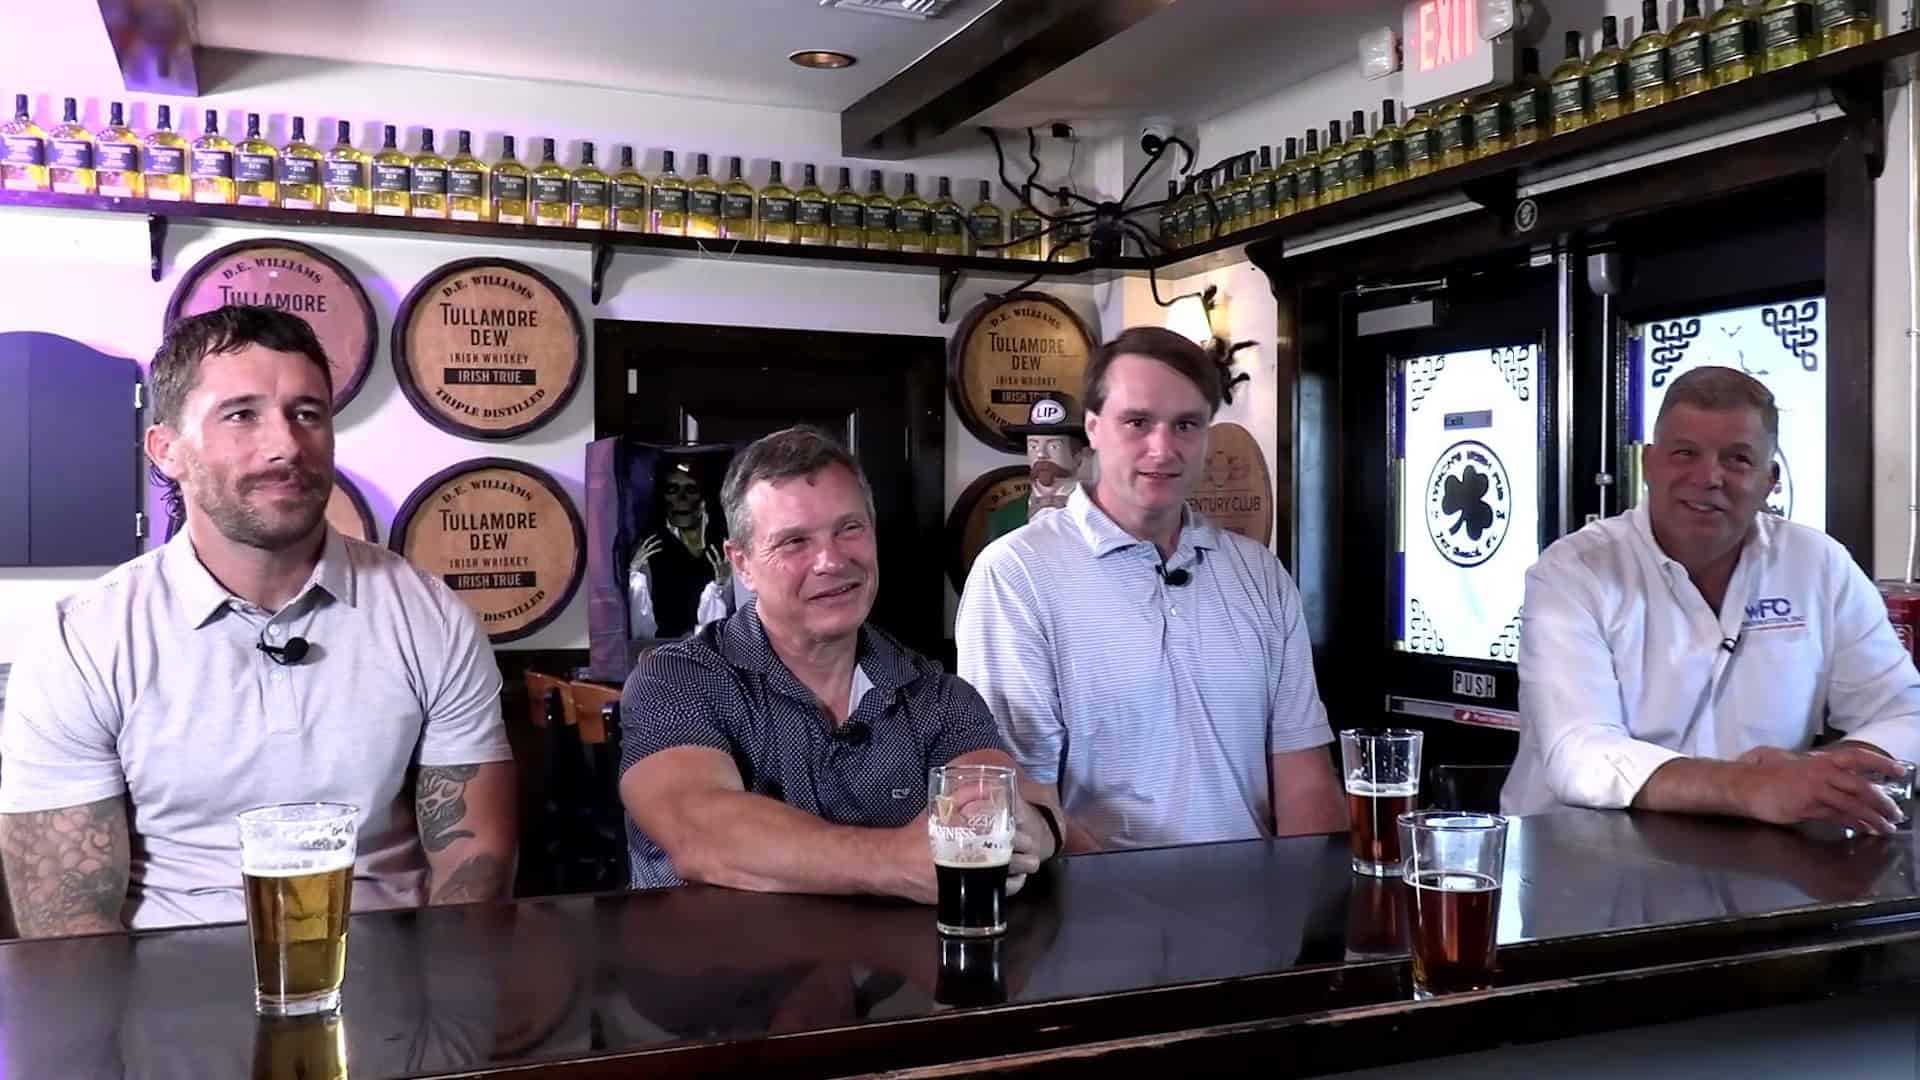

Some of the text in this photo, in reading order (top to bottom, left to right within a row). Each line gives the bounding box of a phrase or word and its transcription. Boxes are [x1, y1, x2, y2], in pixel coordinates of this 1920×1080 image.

[255, 257, 322, 283] WILLIAMS
[471, 275, 534, 299] WILLIAMS
[440, 303, 538, 327] TULLAMORE
[471, 329, 509, 347] DEW
[988, 332, 1064, 354] TULLAMORE
[450, 352, 529, 365] IRISH WHISKEY
[1012, 355, 1041, 371] DEW
[459, 370, 522, 384] IRISH TRUE
[436, 386, 545, 418] TRIPLE DISTILLED
[1037, 407, 1058, 417] LIP
[471, 480, 533, 501] WILLIAMS
[1232, 495, 1261, 512] CLUB
[438, 509, 537, 531] TULLAMORE
[470, 533, 508, 551] DEW
[450, 556, 528, 569] IRISH WHISKEY
[458, 573, 521, 588] IRISH TRUE
[484, 590, 545, 622] DISTILLED
[1455, 672, 1494, 697] PUSH
